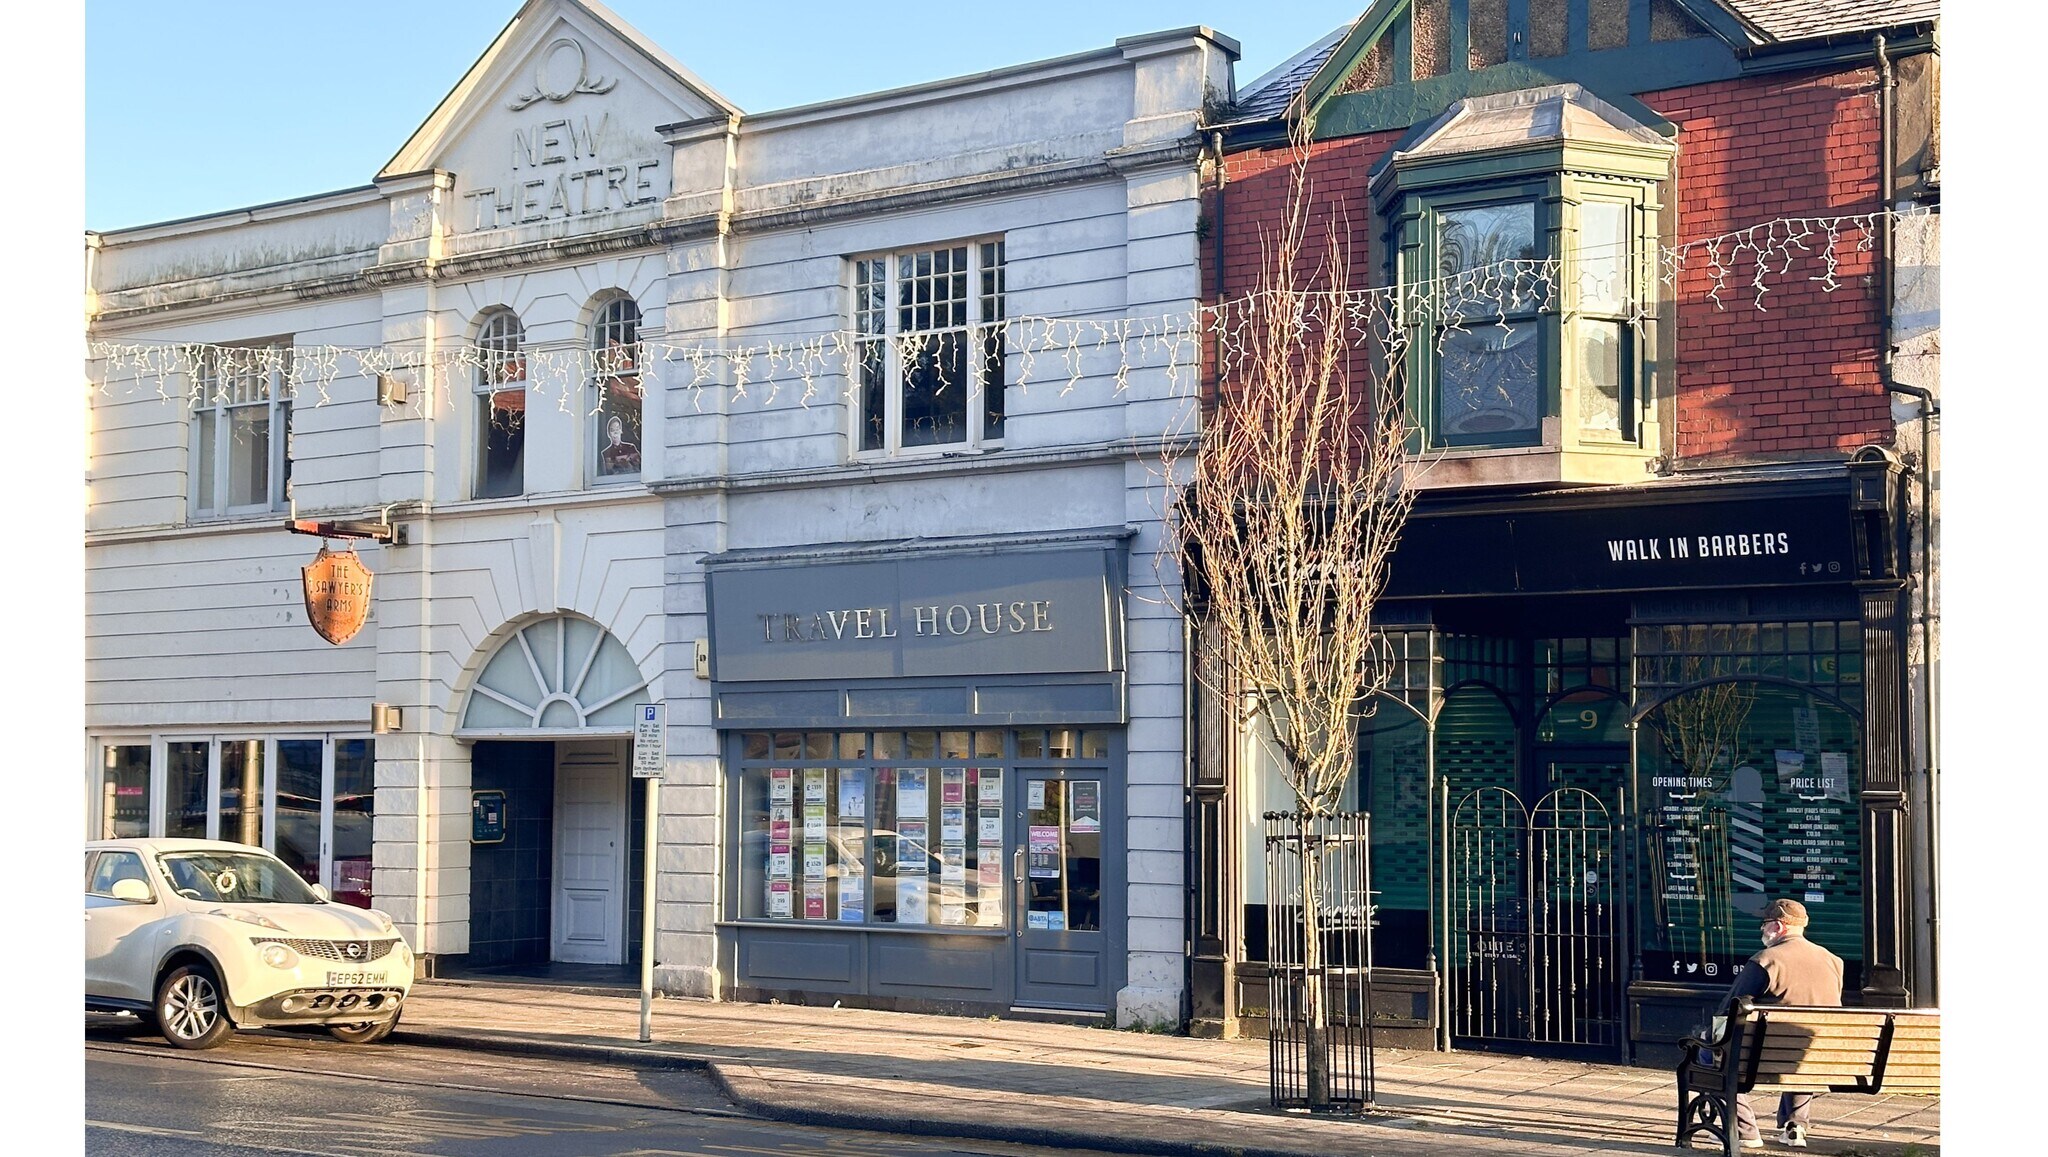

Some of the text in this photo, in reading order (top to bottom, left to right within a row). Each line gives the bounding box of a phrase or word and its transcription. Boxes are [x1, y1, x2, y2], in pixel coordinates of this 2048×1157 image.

[513, 112, 609, 170] NEW
[463, 159, 659, 230] THEATRE
[1607, 532, 1789, 562] WALK IN BARBERS
[331, 565, 349, 579] THE
[316, 580, 363, 596] SAWYER'S
[326, 599, 352, 612] ARMS
[757, 600, 1053, 642] TRAVEL HOUSE
[1580, 709, 1598, 729] 9
[1652, 776, 1713, 788] OPENING TIMES
[1790, 777, 1835, 788] PRICE LIST
[1031, 830, 1058, 838] WELCOME
[337, 973, 365, 985] EP62
